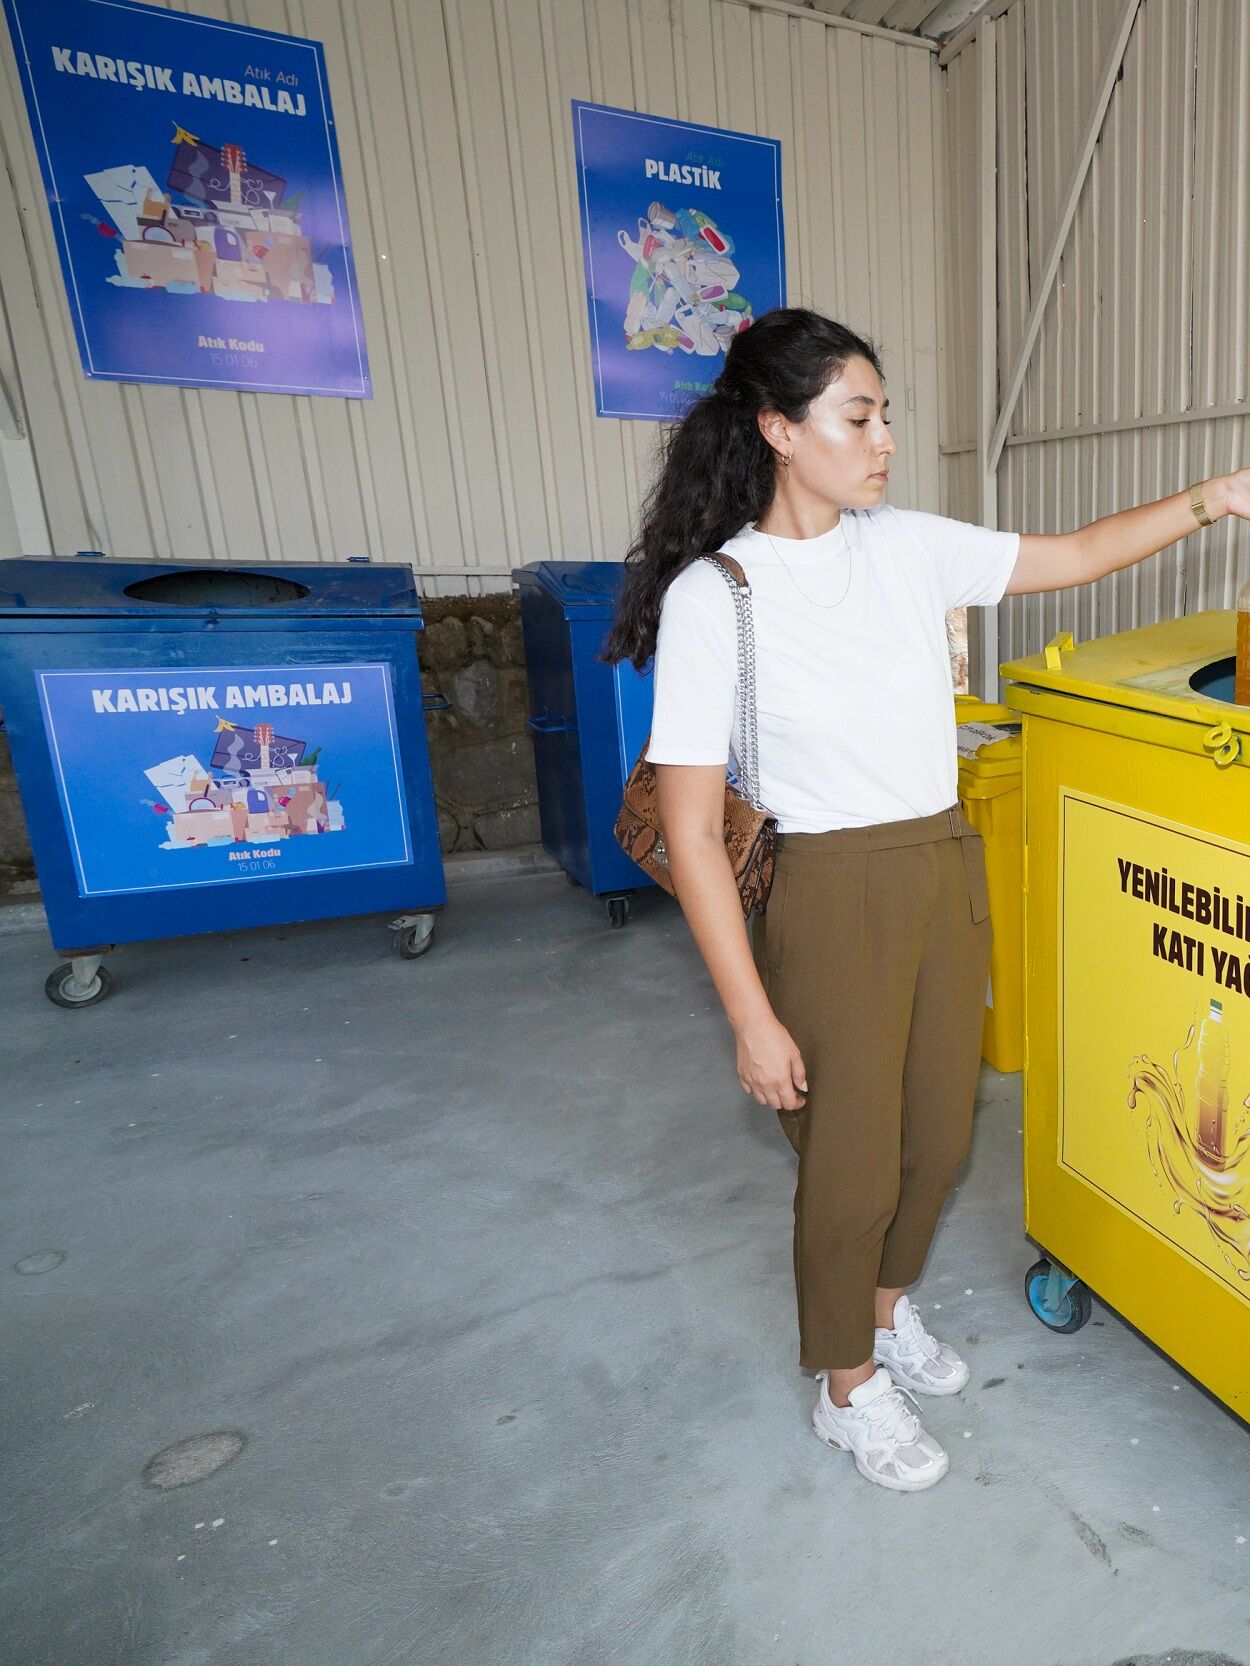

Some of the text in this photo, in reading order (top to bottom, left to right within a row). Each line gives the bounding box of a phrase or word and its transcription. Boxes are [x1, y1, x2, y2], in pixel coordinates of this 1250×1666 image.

[51, 46, 307, 116] KARIŞIK AMBALAJ
[244, 64, 299, 87] Atık Adı
[644, 158, 722, 190] PLASTİK
[198, 335, 265, 353] Atık Kodu
[92, 682, 352, 715] KARIŞIK AMBALAJ
[229, 848, 281, 861] Atık Kodu
[238, 859, 276, 872] 15 01 06
[1153, 922, 1204, 977] KATI
